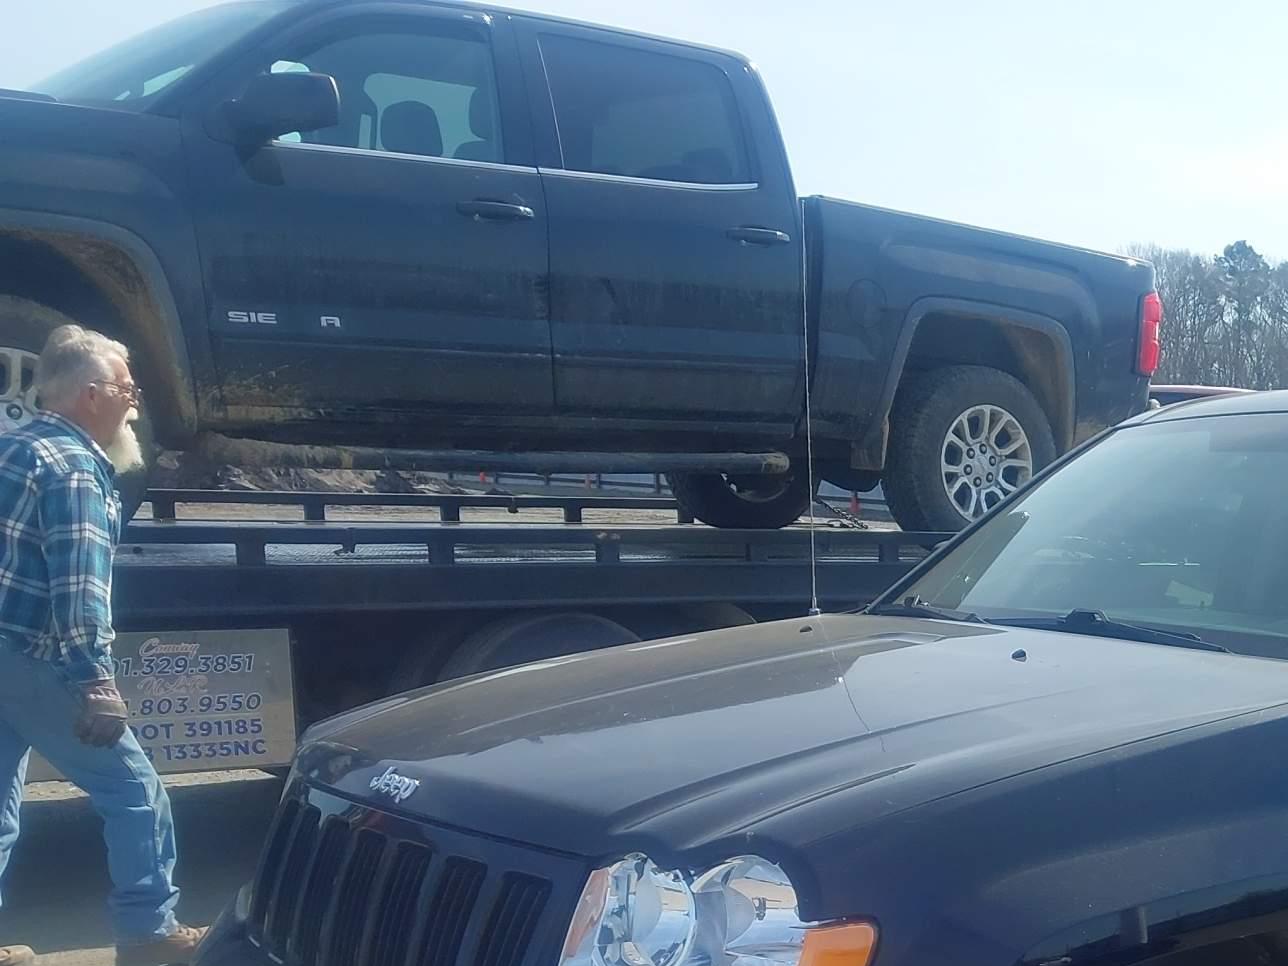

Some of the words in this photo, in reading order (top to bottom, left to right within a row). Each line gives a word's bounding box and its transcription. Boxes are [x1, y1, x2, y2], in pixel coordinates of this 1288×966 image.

[184, 718, 263, 738] 391185
[162, 739, 267, 761] 13335NC
[369, 766, 420, 803] Jeep
